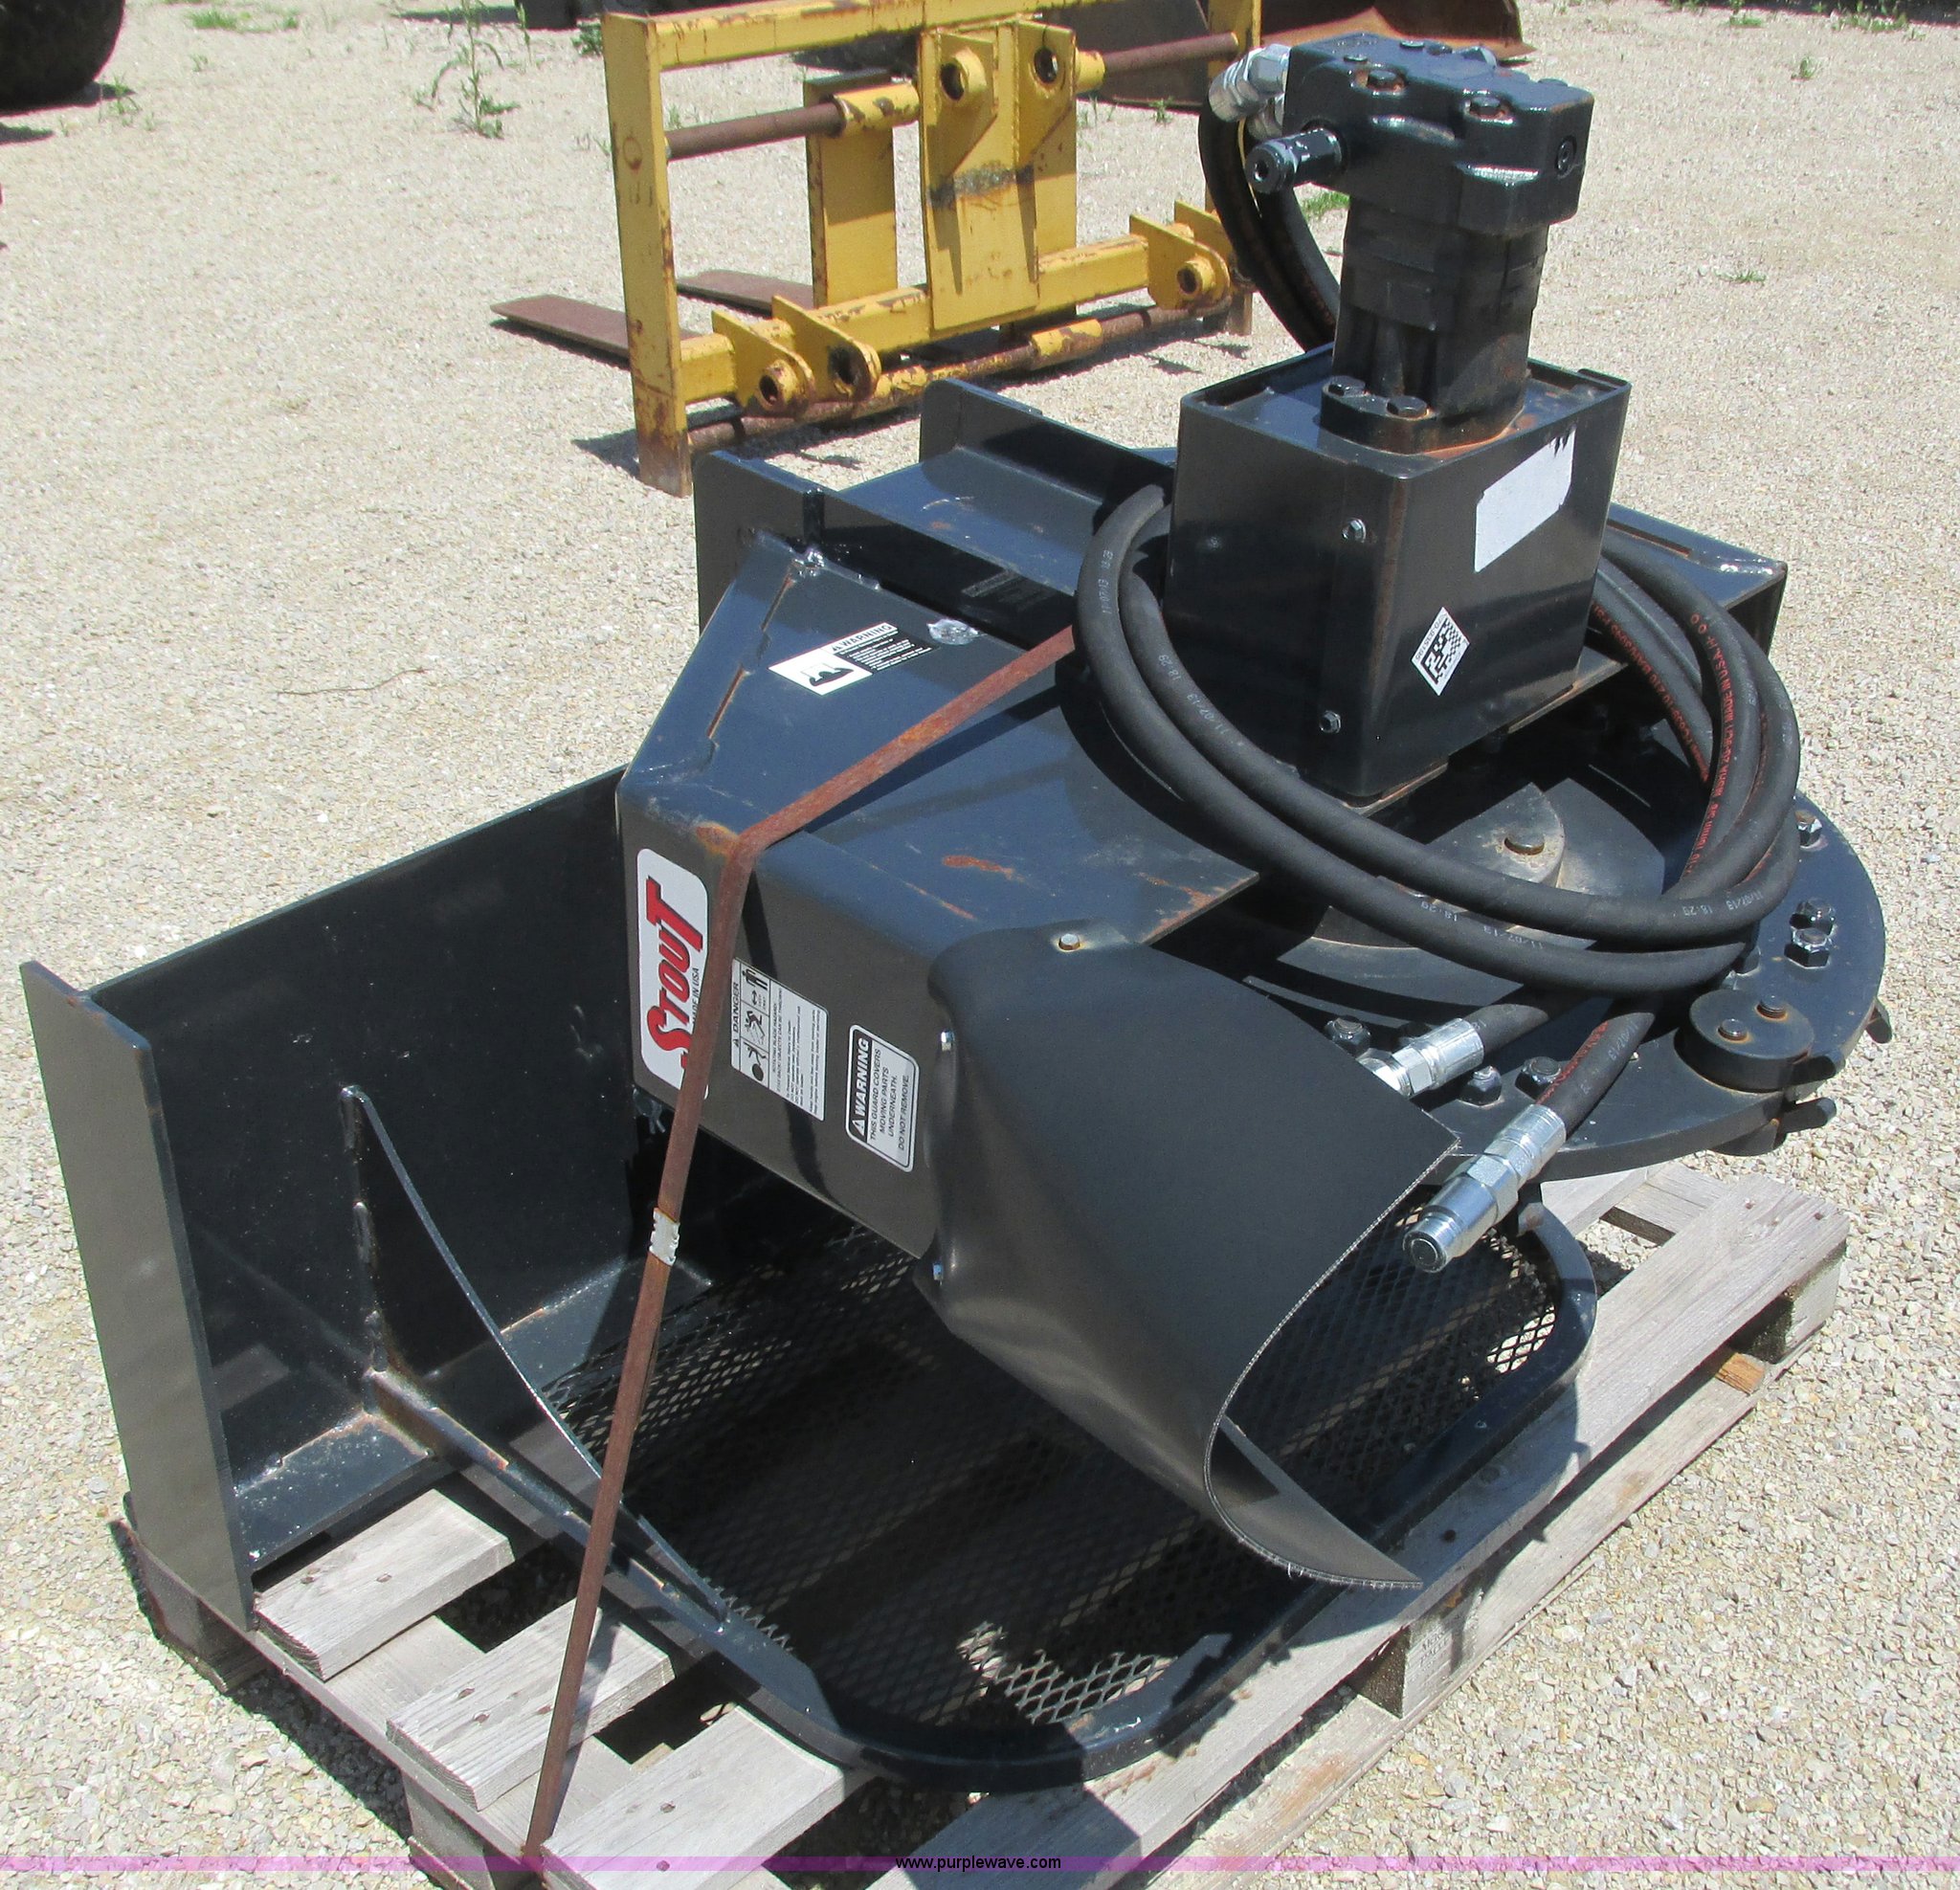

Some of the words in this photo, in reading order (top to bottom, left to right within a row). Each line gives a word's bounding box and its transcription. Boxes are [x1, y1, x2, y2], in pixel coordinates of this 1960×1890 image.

[841, 625, 892, 647] WARNING
[1720, 677, 1731, 690] IN
[1722, 690, 1734, 721] MADE
[646, 875, 703, 1071] STOUT
[692, 967, 701, 987] USA
[692, 988, 700, 998] IN
[856, 1037, 869, 1116] WARNING
[873, 1048, 881, 1086] COVERS
[871, 1088, 880, 1121] GUARD
[880, 1098, 888, 1134] MOVING
[888, 1075, 898, 1137] UNDERNEATH.
[898, 1136, 904, 1150] DO
